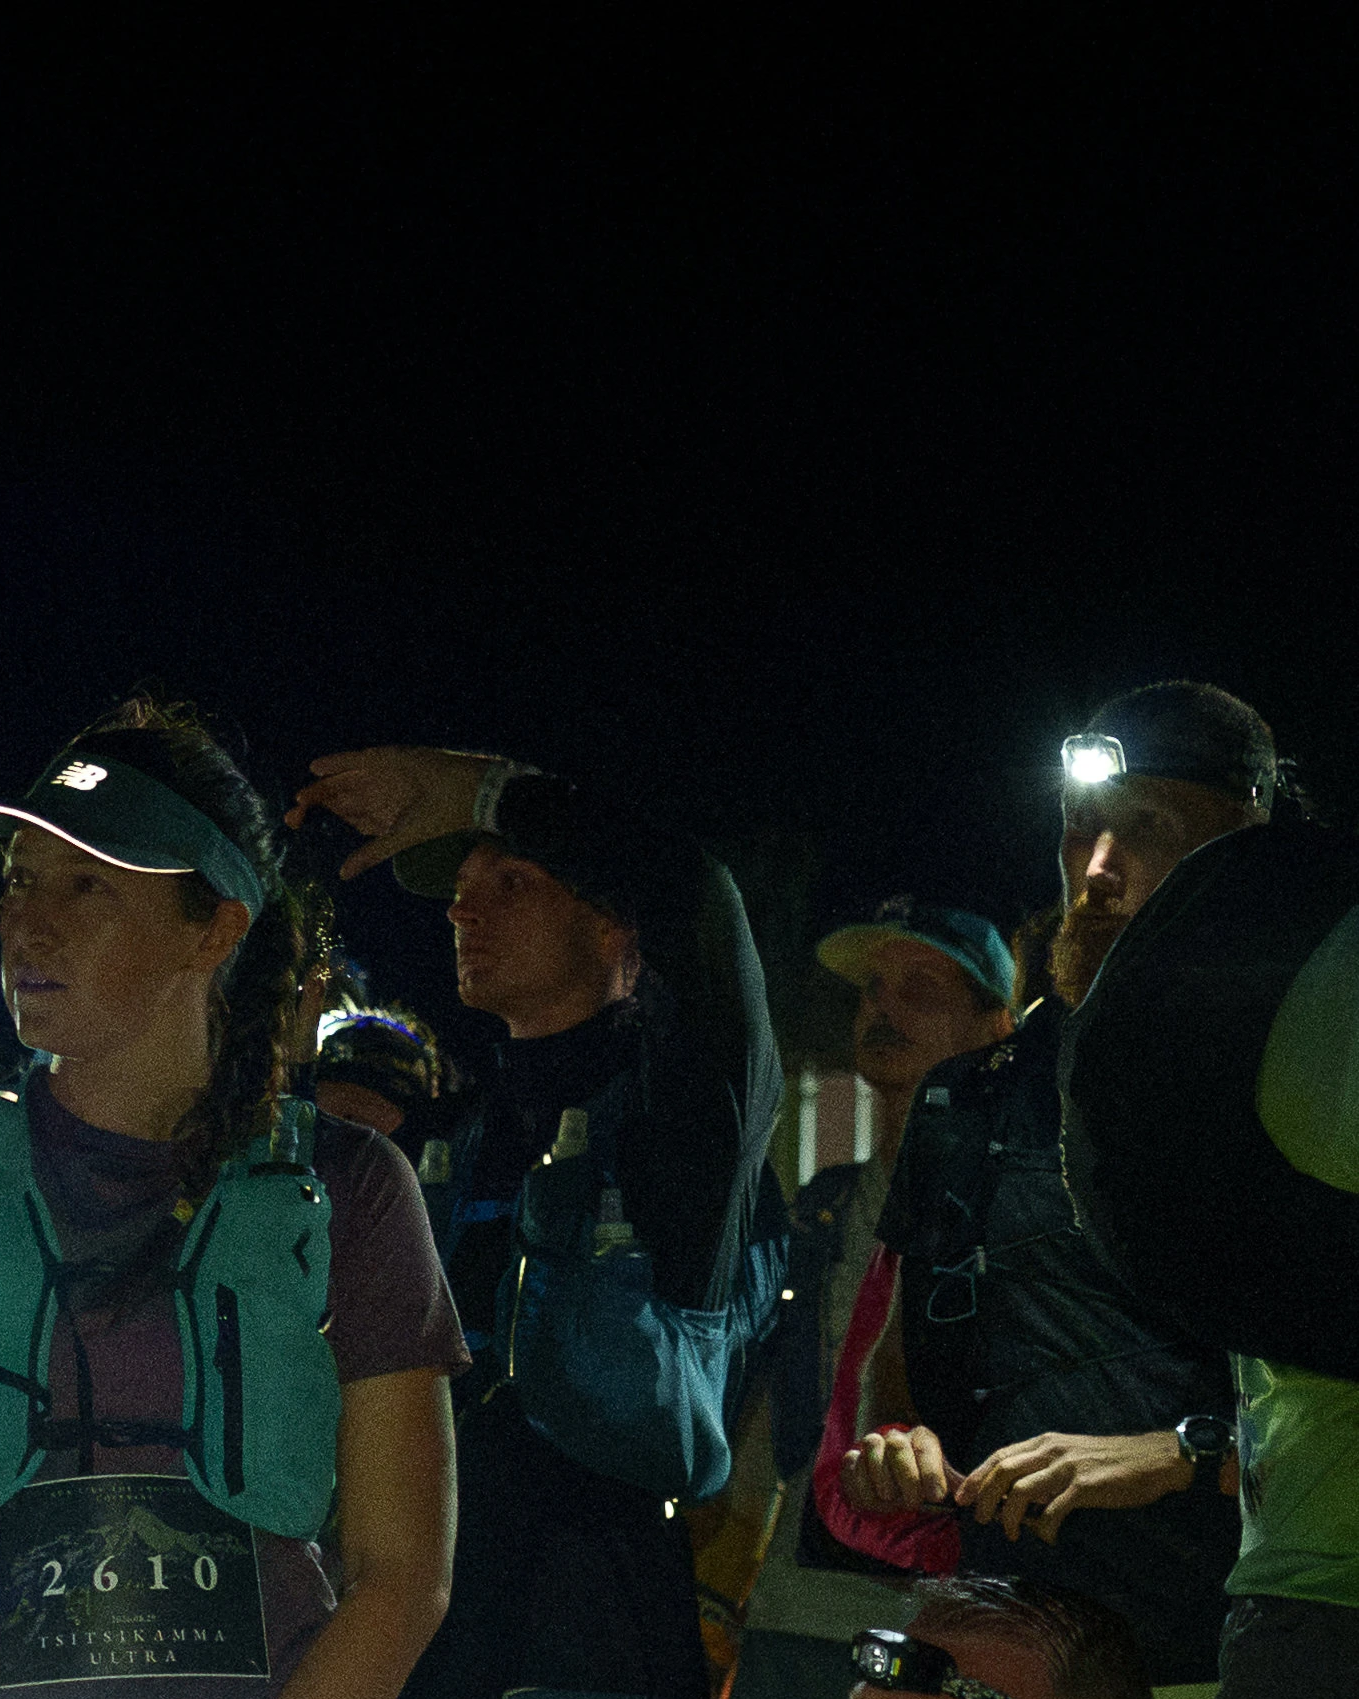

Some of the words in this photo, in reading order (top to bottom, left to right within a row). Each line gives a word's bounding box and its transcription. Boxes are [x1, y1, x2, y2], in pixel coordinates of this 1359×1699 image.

[42, 1554, 218, 1597] 2610
[38, 1628, 225, 1649] TSITSIKAMMA
[90, 1650, 177, 1665] ULTRA
